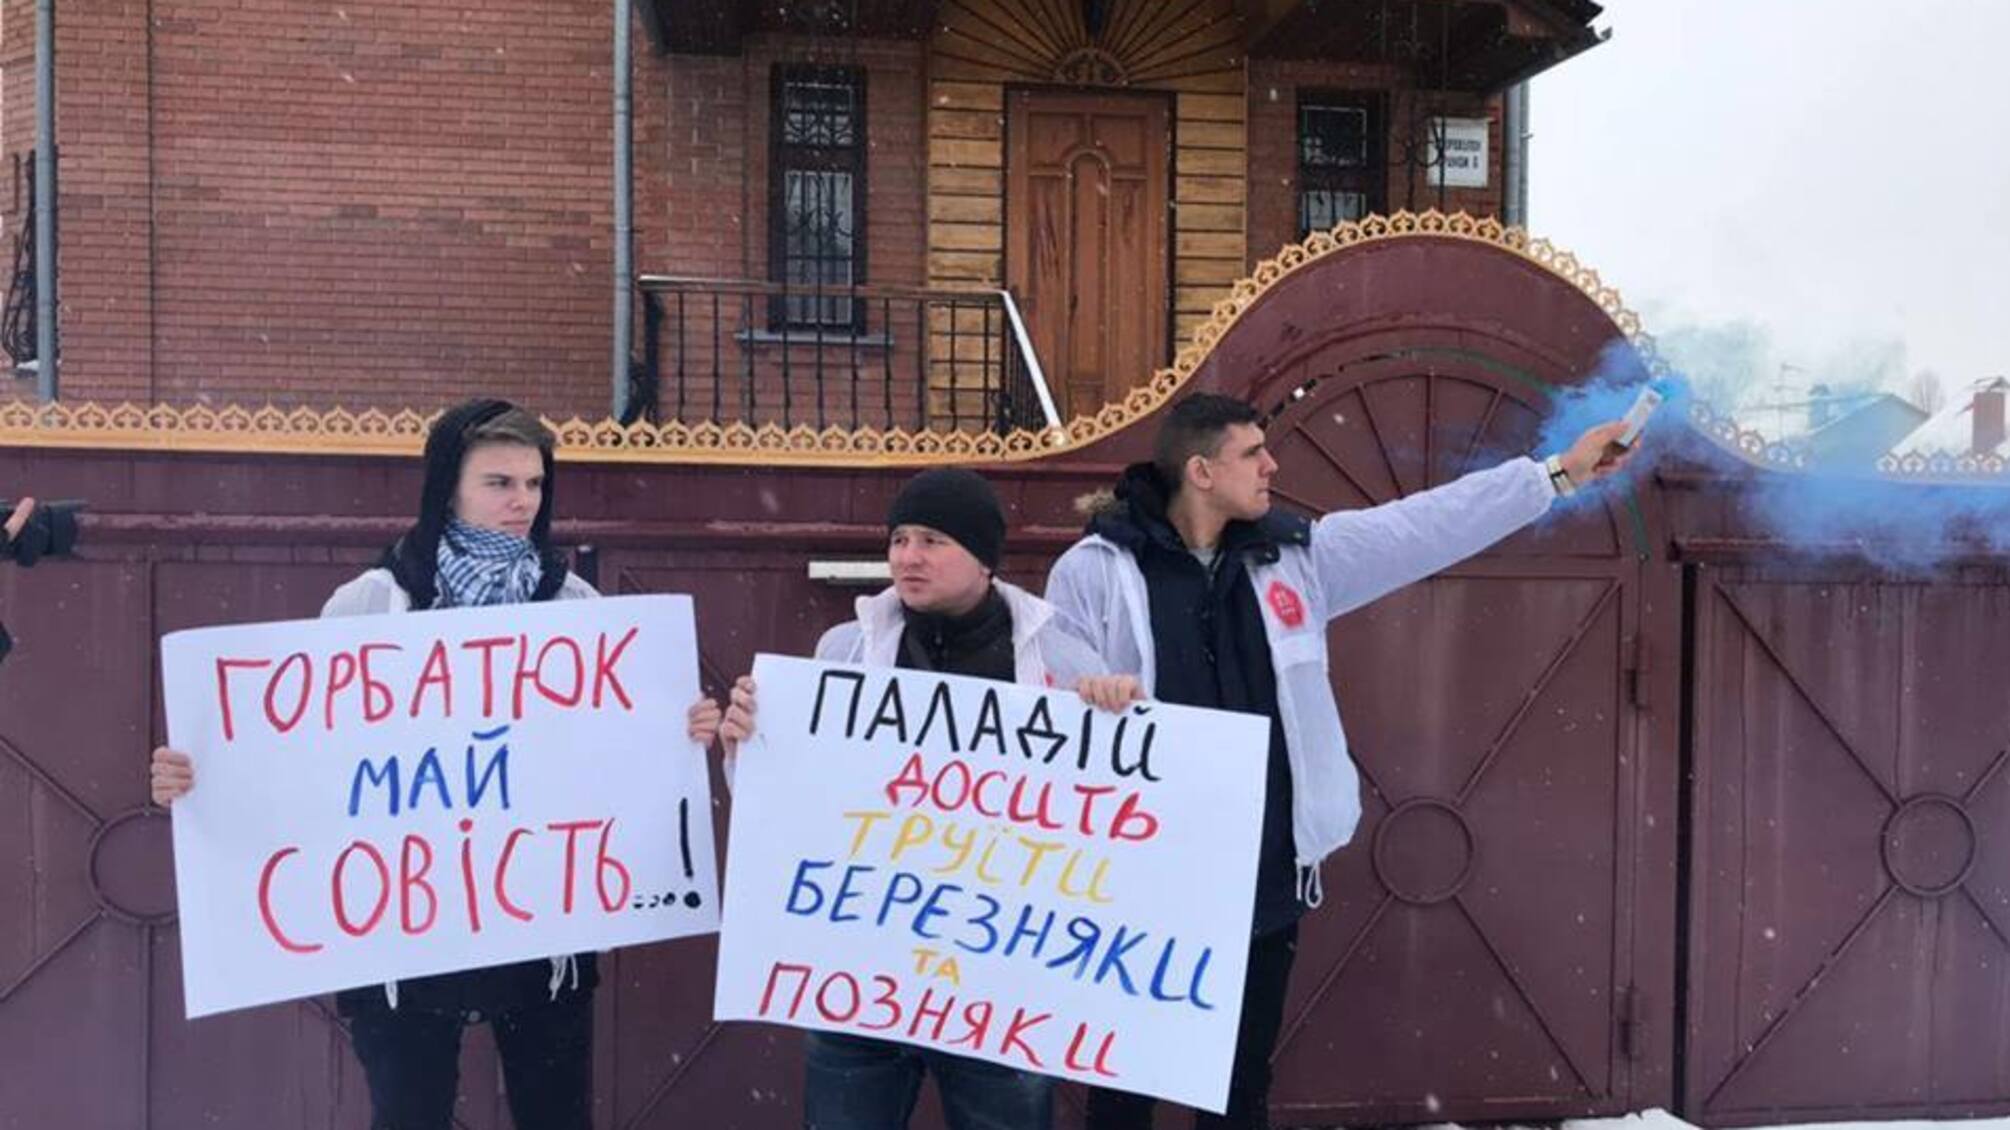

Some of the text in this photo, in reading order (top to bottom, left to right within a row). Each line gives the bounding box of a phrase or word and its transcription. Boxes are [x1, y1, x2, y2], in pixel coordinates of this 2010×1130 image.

[216, 627, 638, 741] ГОРБАТЮК
[809, 669, 1162, 781] ПАЛАДІЙ
[348, 725, 510, 816] МАЙ
[885, 753, 1158, 841] ДОСИТЬ
[843, 810, 1115, 902] ТРУЇТИ
[786, 860, 1217, 1010] БЕРЕЗНЯКИ
[912, 948, 960, 985] ТА
[758, 961, 1118, 1077] ПОЗНЯКИ
